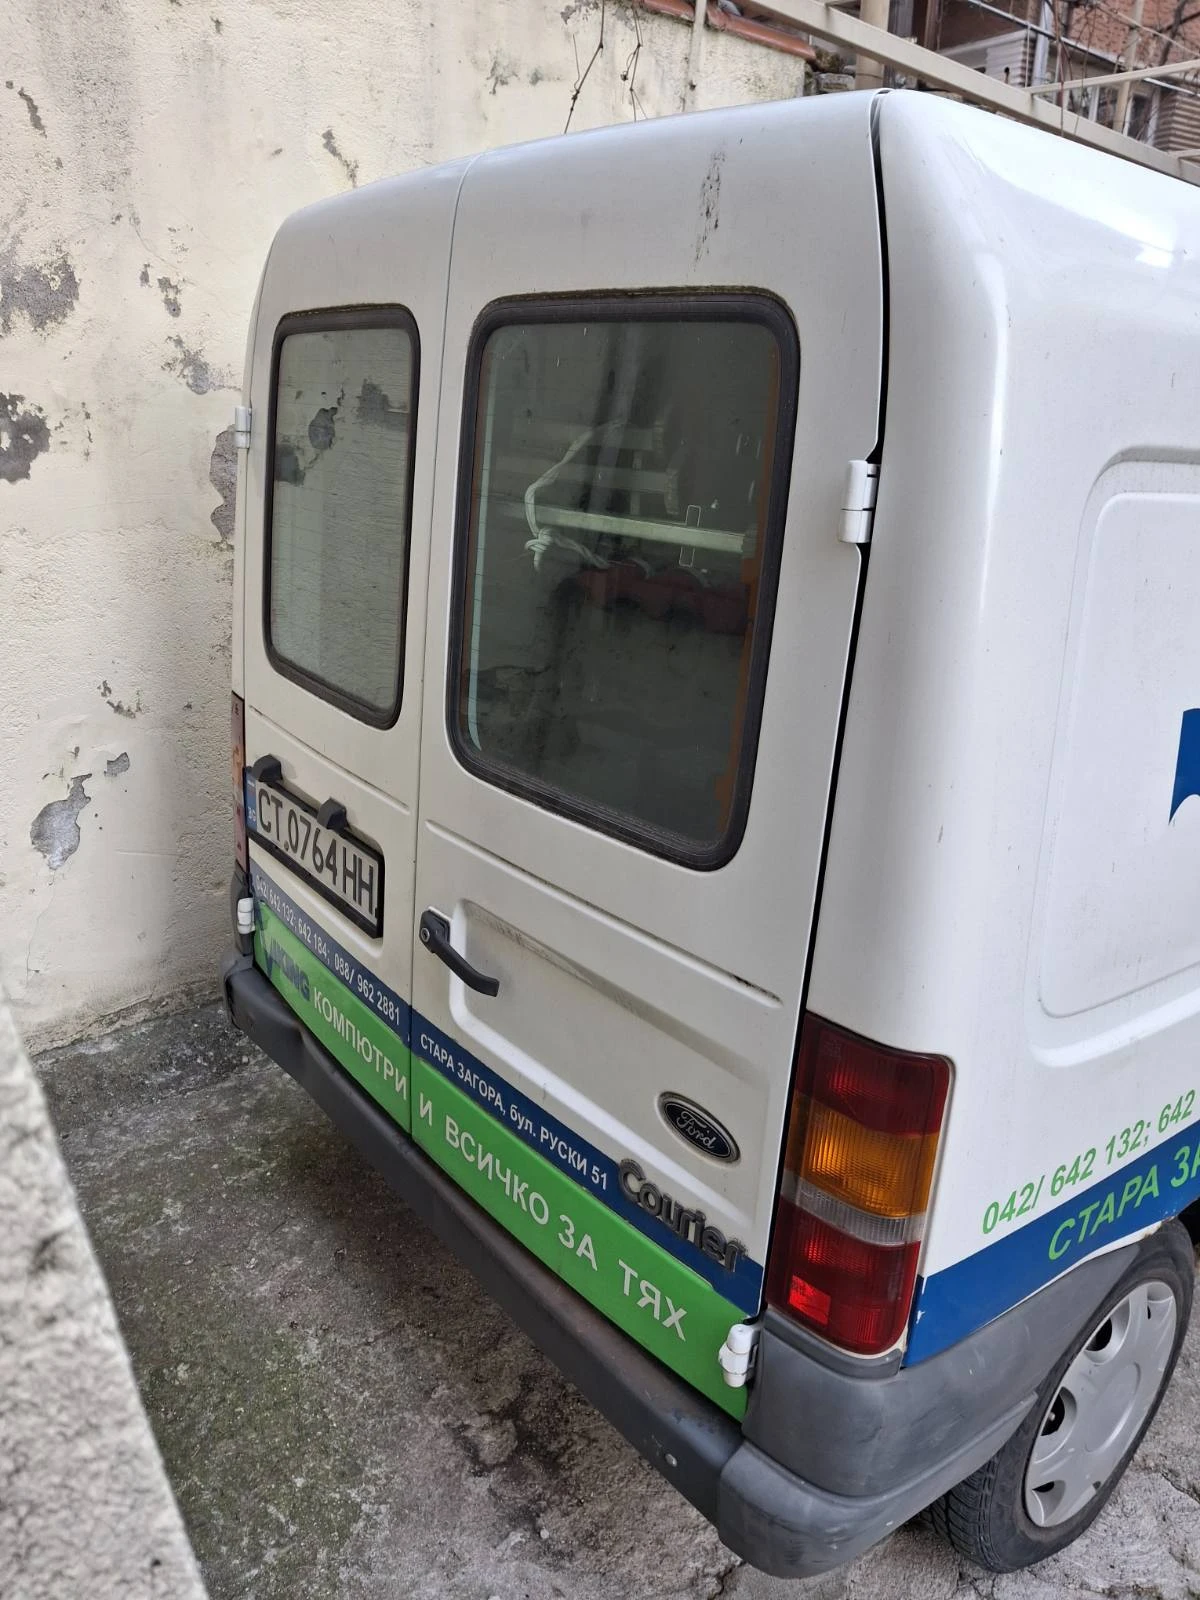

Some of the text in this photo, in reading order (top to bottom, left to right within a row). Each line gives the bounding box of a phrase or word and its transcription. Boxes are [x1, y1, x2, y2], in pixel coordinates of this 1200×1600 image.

[270, 889, 281, 912] 642
[298, 918, 312, 944] 642
[313, 933, 331, 964] 184;
[334, 952, 354, 984] 088/
[357, 974, 374, 1003] 962
[377, 991, 400, 1025] 2881
[420, 1033, 455, 1073] СТАРА
[457, 1062, 506, 1116] ЗАГОРА,
[509, 1104, 536, 1137] бул.
[540, 1126, 587, 1176] РУСКИ
[591, 1166, 607, 1190] 51
[314, 987, 687, 1342] КОМПЮТРИ И ВСИЧКО ЗА ТЯХ
[676, 1111, 717, 1149] Ford
[982, 1089, 1195, 1235] 042/ 642 132; 642
[618, 1158, 747, 1273] Courier
[1048, 1164, 1160, 1261] СТАРА
